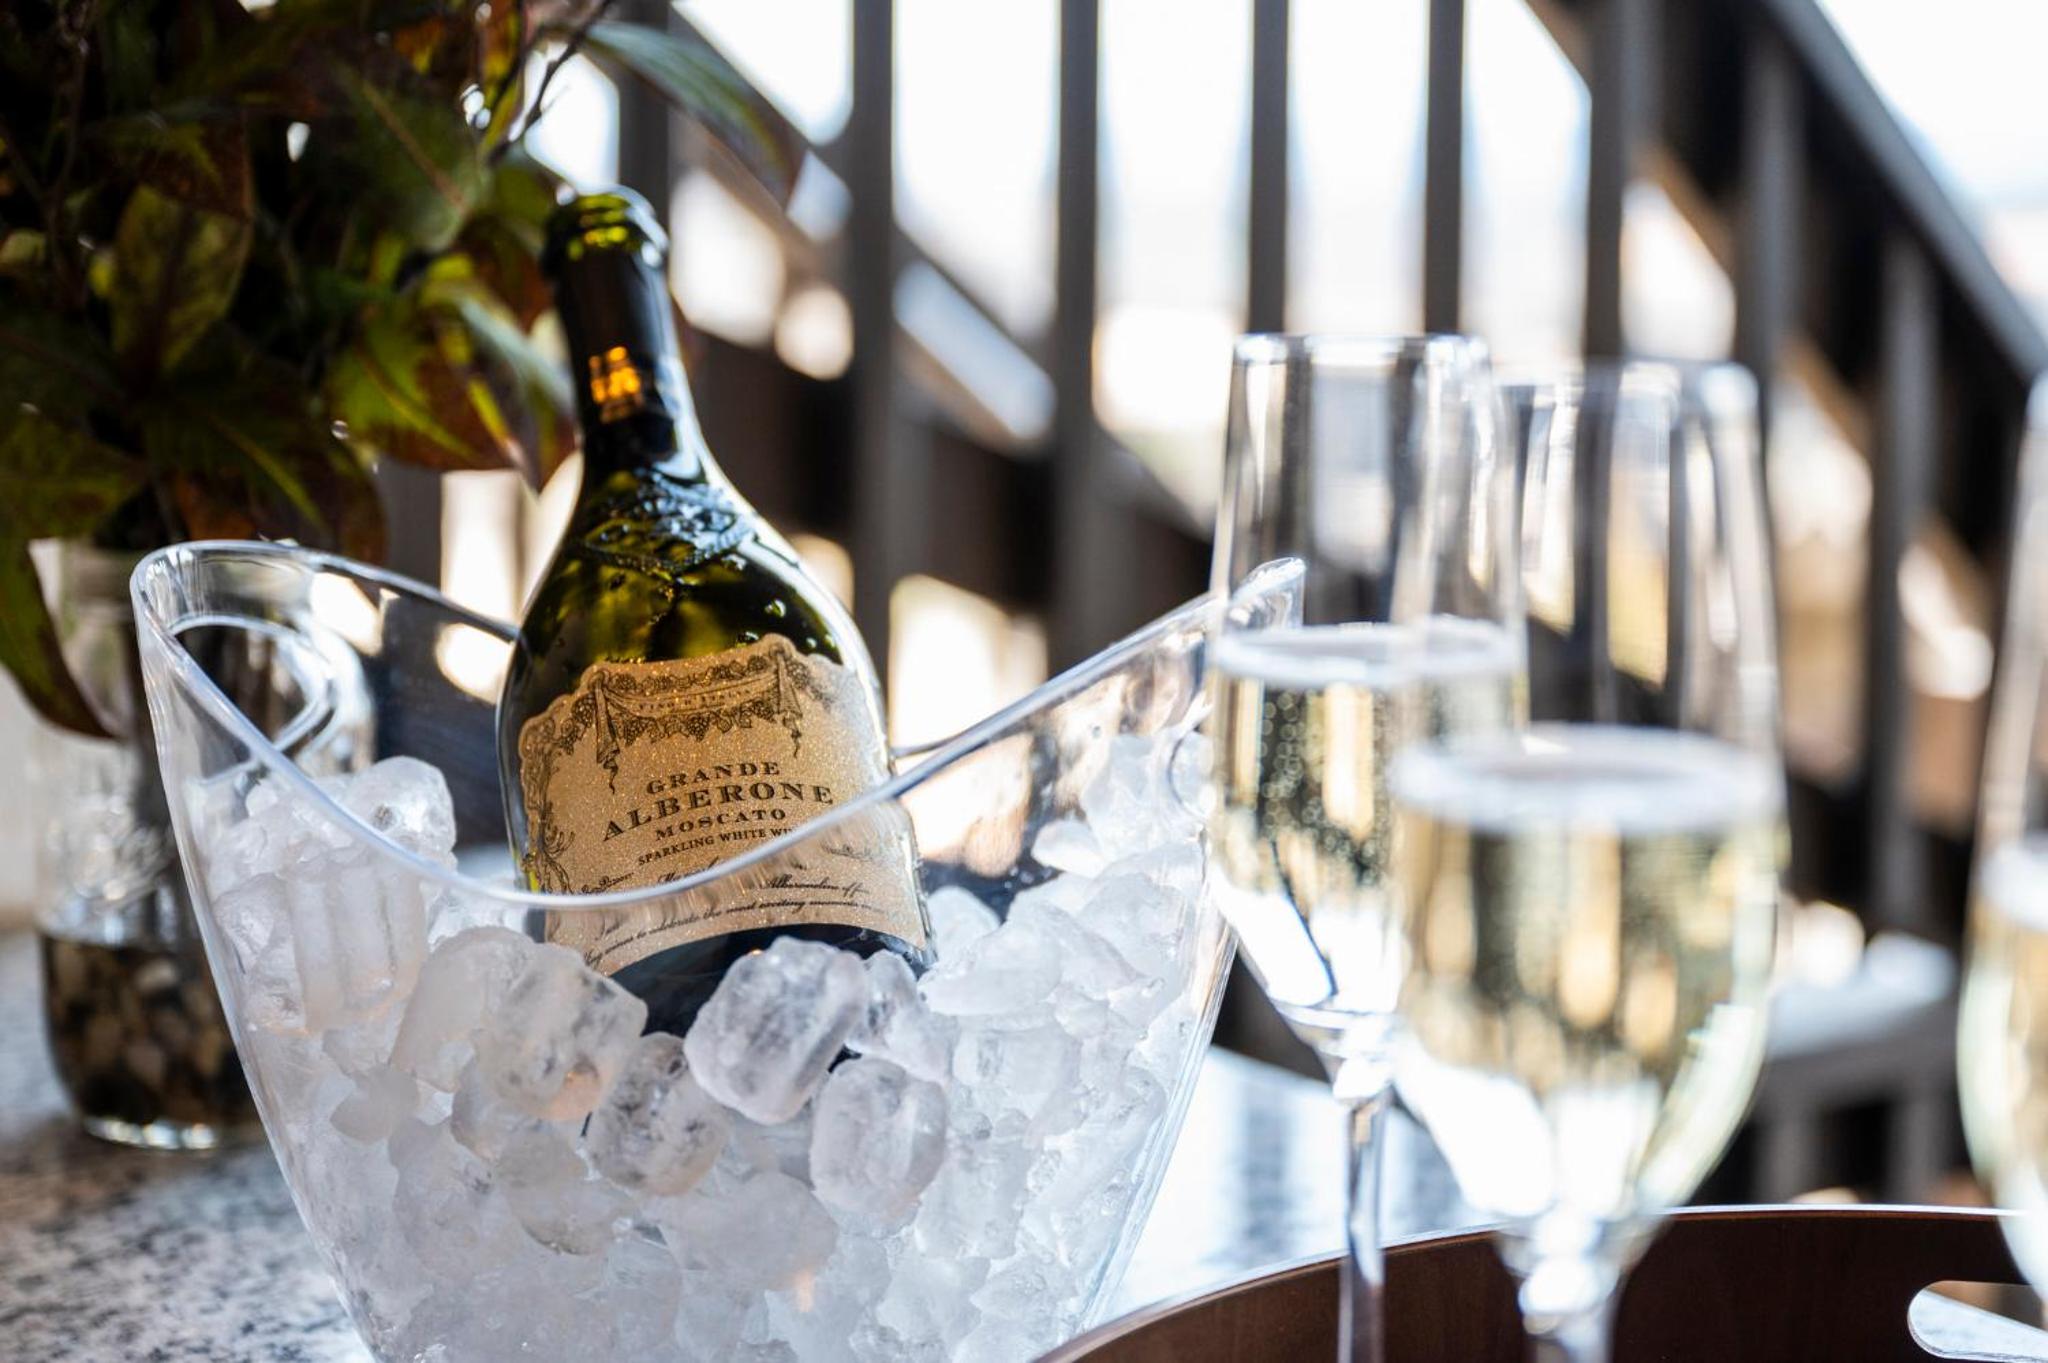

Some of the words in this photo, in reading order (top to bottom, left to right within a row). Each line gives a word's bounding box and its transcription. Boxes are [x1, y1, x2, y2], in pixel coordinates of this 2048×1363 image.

[646, 761, 781, 795] GRANDE
[603, 781, 834, 842] ALBERONE
[655, 808, 786, 841] MOSCATO
[638, 835, 715, 866] SPARKLING
[718, 828, 766, 843] WHITE
